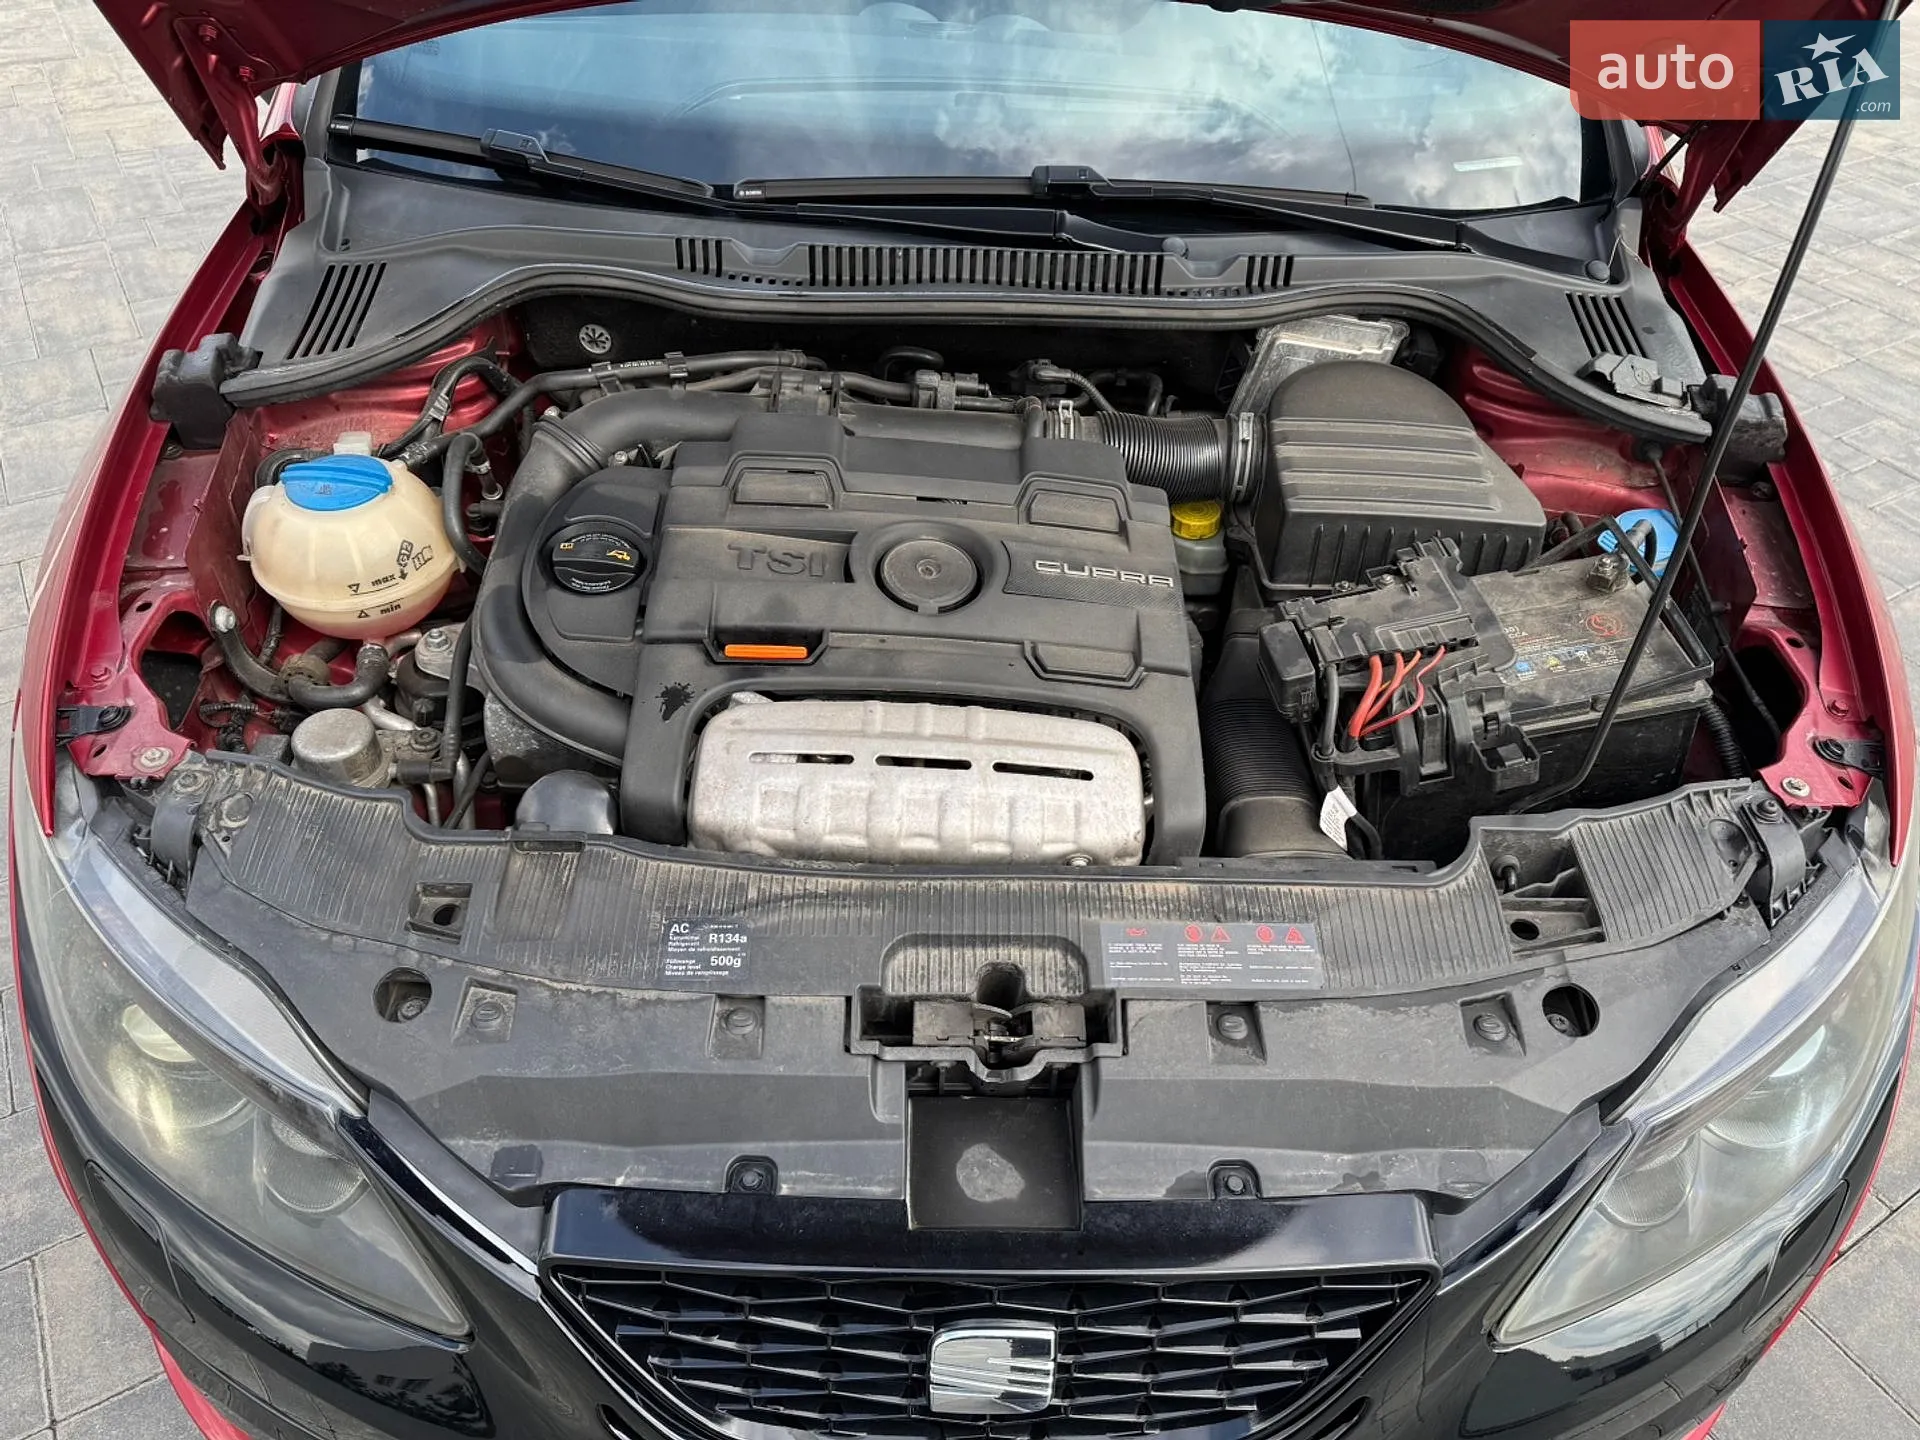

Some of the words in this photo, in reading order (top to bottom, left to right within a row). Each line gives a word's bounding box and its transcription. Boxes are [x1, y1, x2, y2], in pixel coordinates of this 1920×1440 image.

[727, 543, 825, 577] TSI
[1034, 559, 1155, 588] CUPRA
[371, 574, 396, 587] max
[380, 603, 402, 615] min
[670, 923, 690, 934] AC
[709, 933, 748, 944] R134a
[710, 955, 742, 968] 500g
